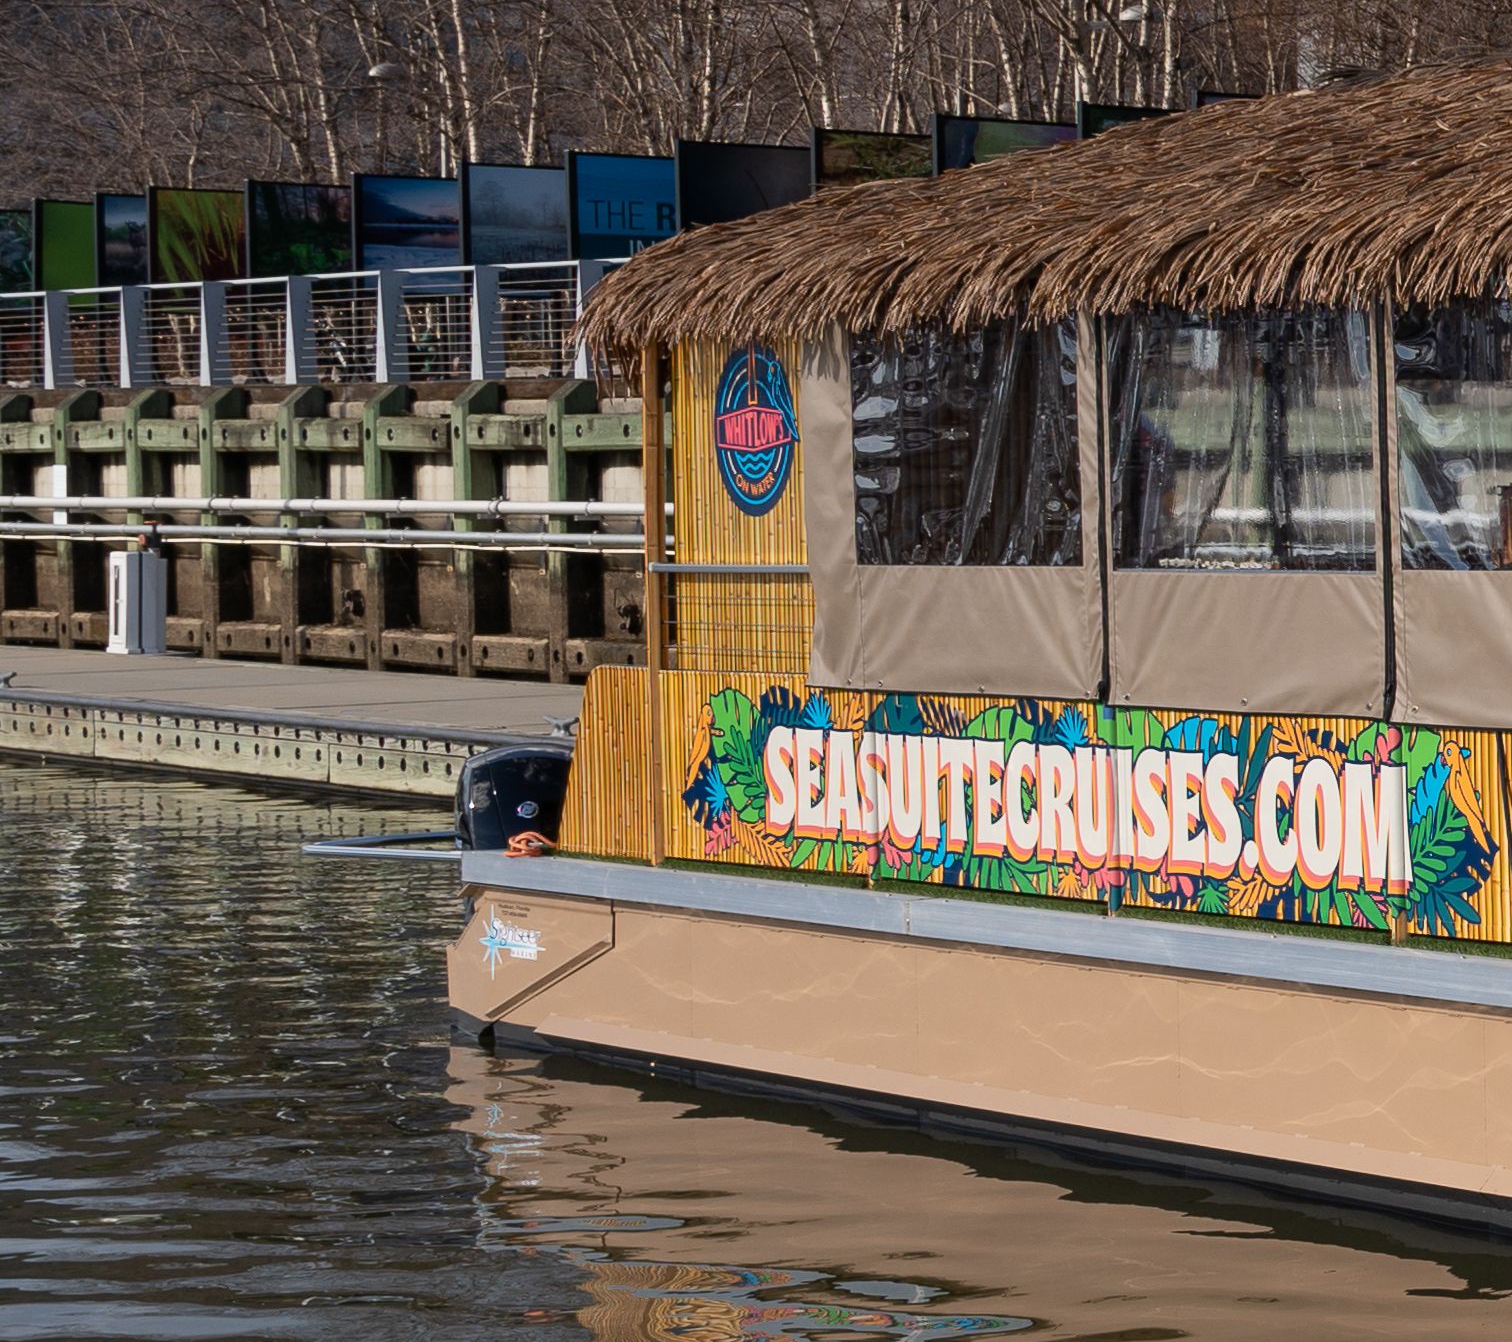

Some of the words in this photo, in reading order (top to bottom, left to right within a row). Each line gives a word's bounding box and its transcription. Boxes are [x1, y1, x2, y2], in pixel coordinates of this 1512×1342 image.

[586, 200, 645, 231] THE
[724, 412, 784, 447] WHITLOW'S
[763, 725, 1413, 895] SEASUITECRUISES.COM
